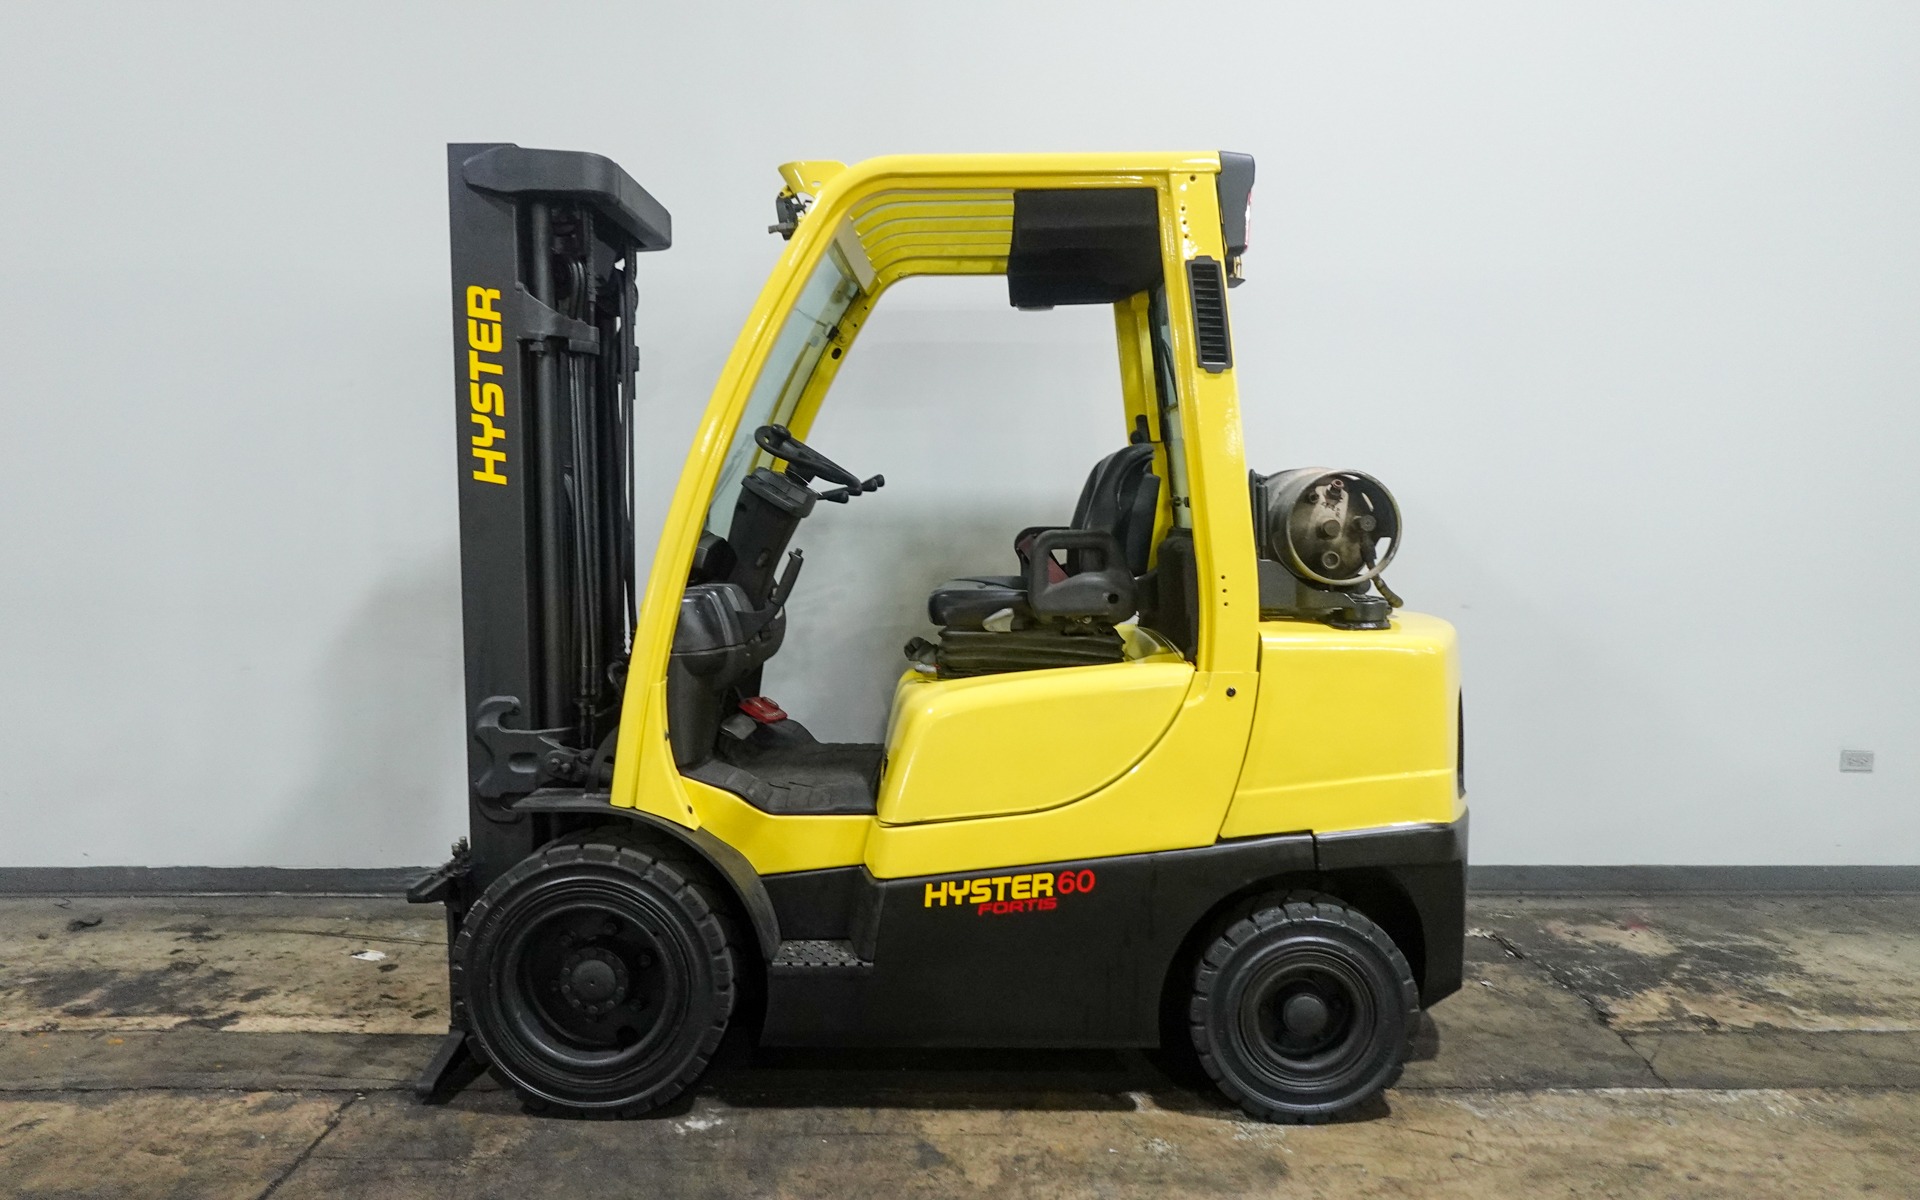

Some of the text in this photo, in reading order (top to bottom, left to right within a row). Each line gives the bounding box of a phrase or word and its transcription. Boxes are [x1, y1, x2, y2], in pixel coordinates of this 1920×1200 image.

[466, 285, 508, 486] HYSTER
[924, 868, 1096, 908] HYSTER 60
[977, 897, 1057, 916] FORTIS
